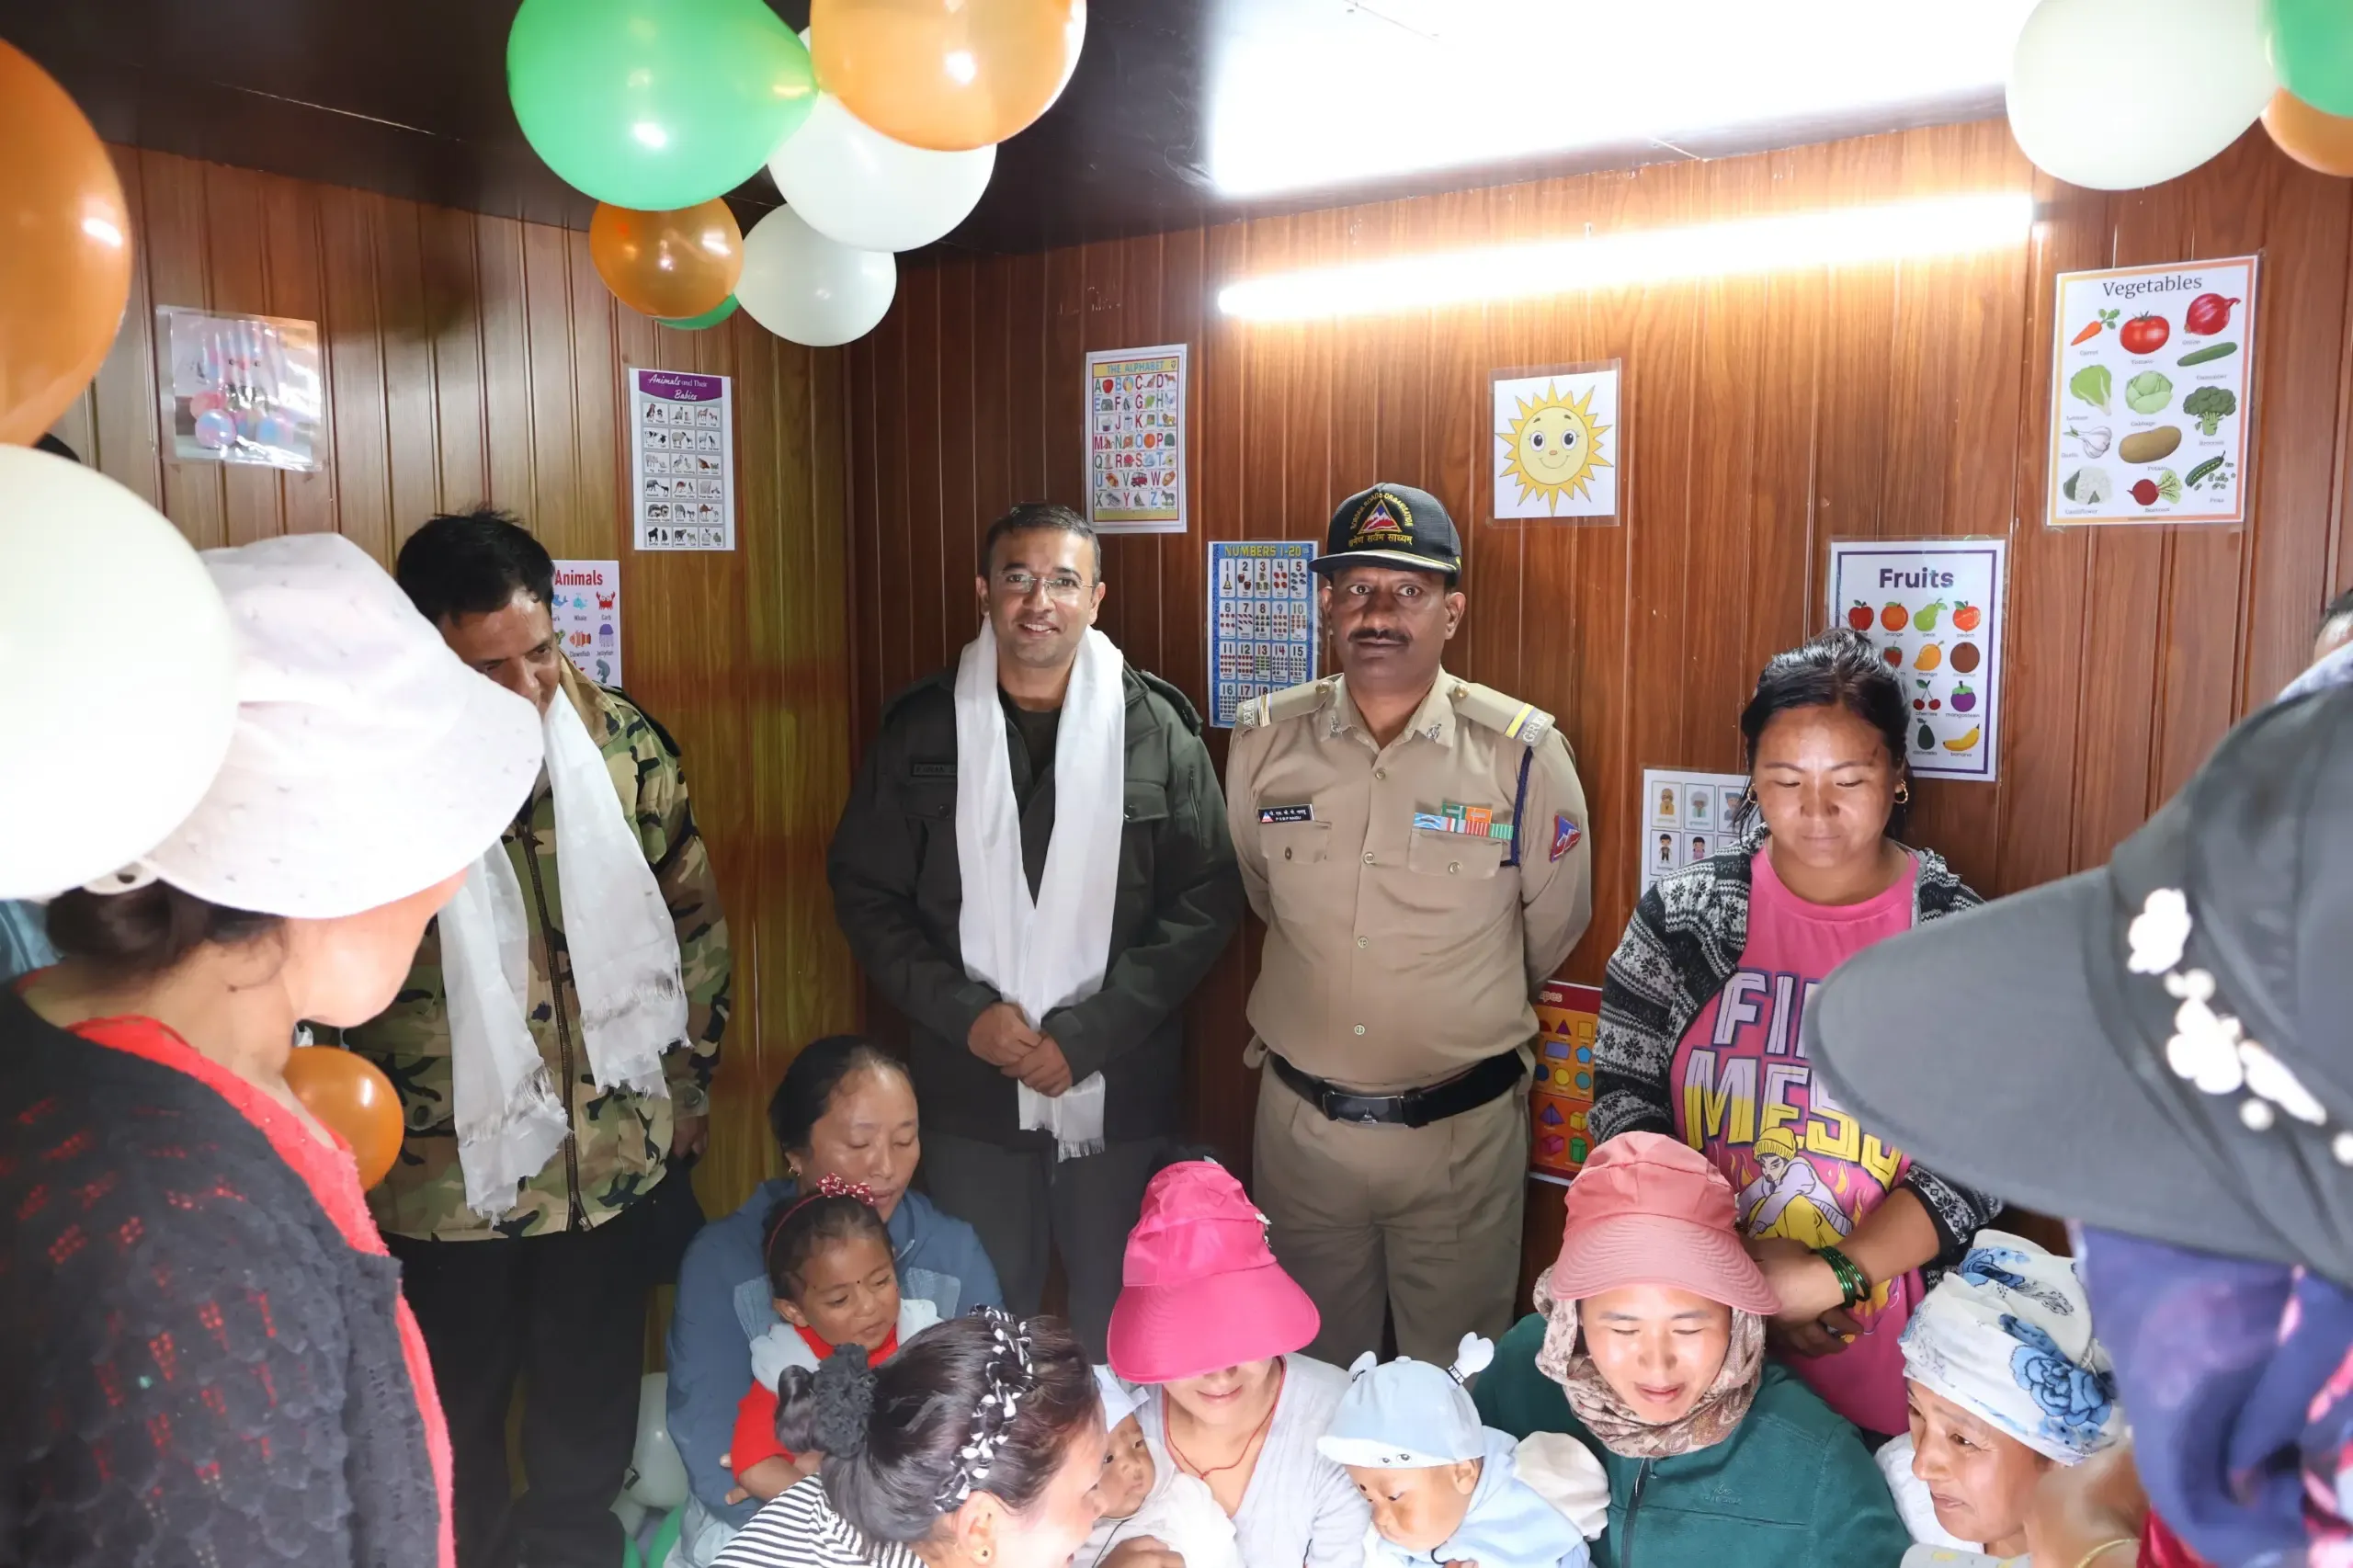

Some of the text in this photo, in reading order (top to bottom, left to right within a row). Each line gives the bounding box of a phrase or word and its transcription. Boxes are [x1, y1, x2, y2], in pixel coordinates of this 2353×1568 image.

[2103, 275, 2202, 299] Vegetables
[1107, 360, 1165, 373] THE ALPHABET
[648, 373, 681, 386] Animals
[694, 380, 708, 388] Their
[1095, 374, 1164, 392] A B C D
[674, 389, 698, 400] Babies
[1095, 393, 1164, 411] E F G H
[1115, 415, 1120, 429] J
[1135, 414, 1142, 428] K
[1095, 433, 1163, 449] M N O P
[1095, 452, 1163, 469] Q R S T
[1096, 471, 1161, 487] U V W
[1096, 492, 1157, 506] X Y Z
[1224, 545, 1276, 557] NUMBERS
[1280, 545, 1302, 557] 1-20
[1242, 562, 1248, 571] 2
[1260, 562, 1266, 571] 3
[1277, 562, 1283, 571] 4
[1296, 562, 1302, 571] 5
[554, 569, 603, 585] Animals
[1879, 567, 1954, 588] Fruits
[1224, 603, 1303, 614] 6 7 8 9 10
[1223, 643, 1303, 656] 11 12 13 14 15
[1222, 685, 1233, 695] 16
[1241, 686, 1250, 695] 17
[1258, 687, 1267, 696] 18
